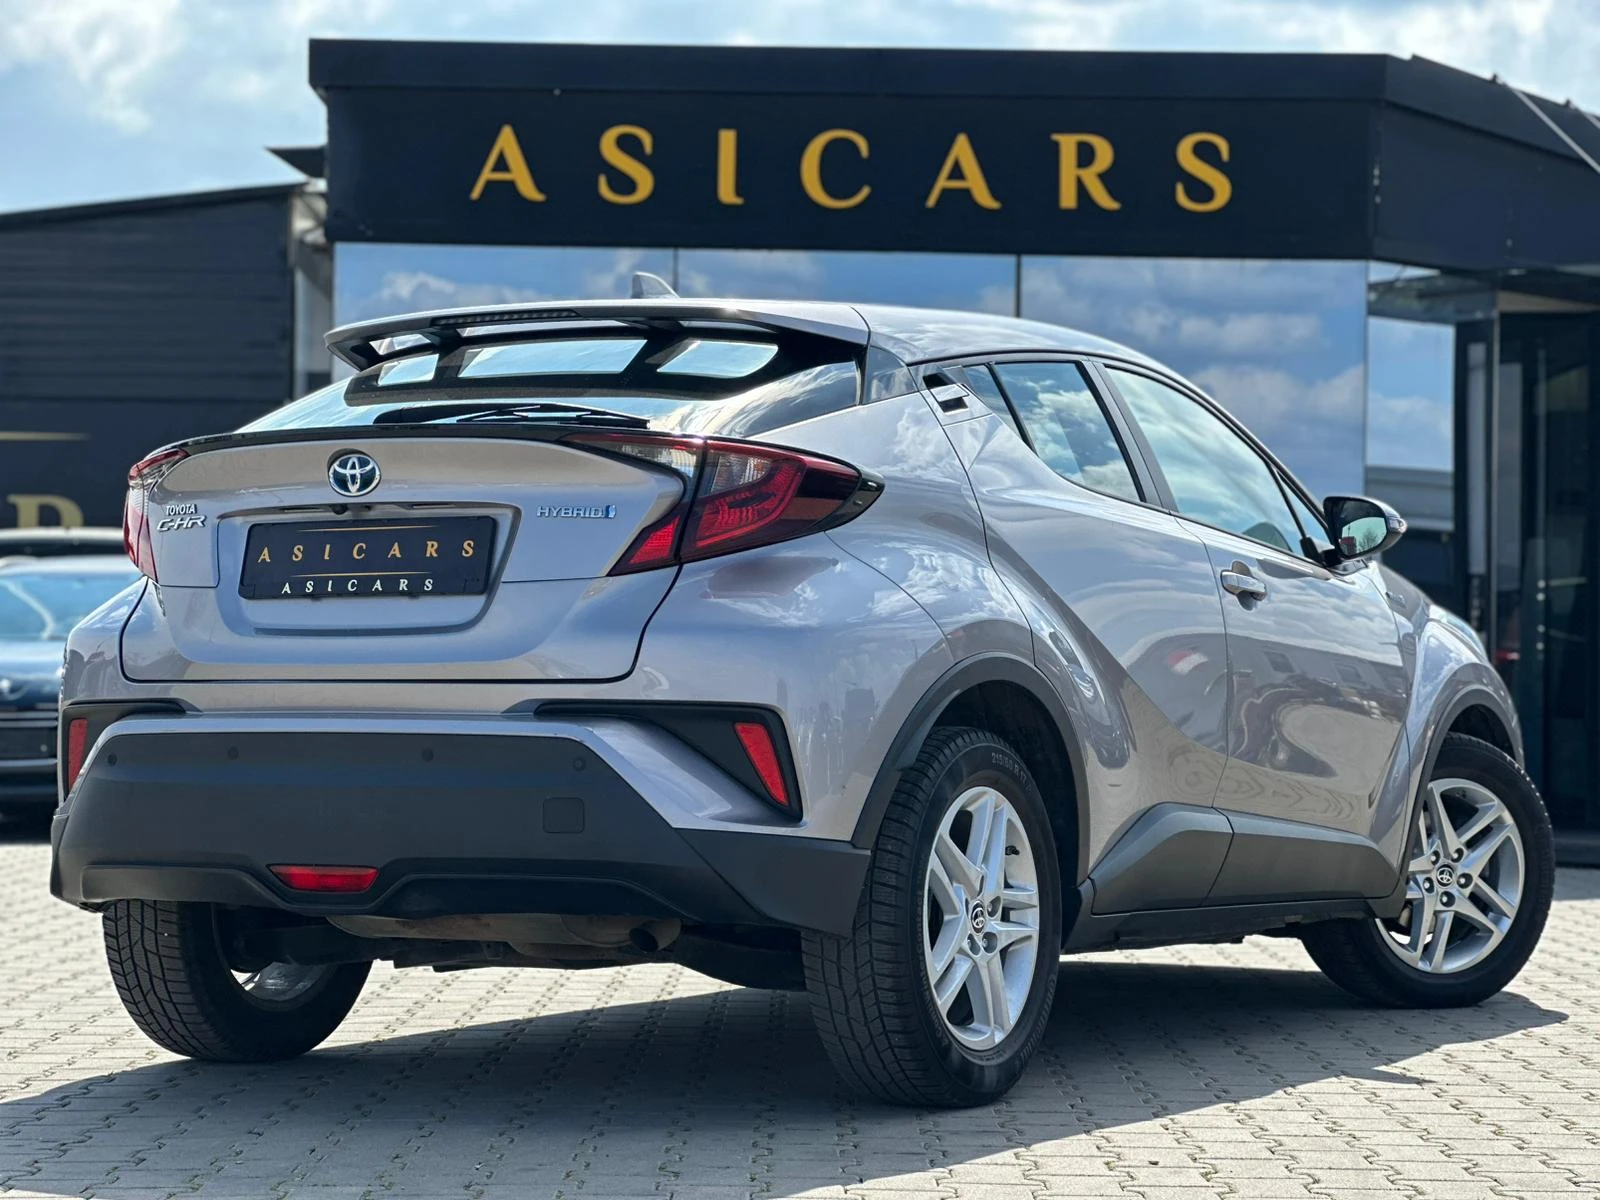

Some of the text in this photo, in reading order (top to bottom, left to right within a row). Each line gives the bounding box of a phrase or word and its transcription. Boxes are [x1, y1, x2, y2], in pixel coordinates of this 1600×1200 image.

[471, 124, 1234, 213] ASICARS
[166, 504, 197, 516] TOYOTA
[536, 506, 603, 519] HYBRID
[156, 515, 207, 532] C-HR
[258, 540, 475, 563] ASICARS
[281, 578, 434, 595] ASICARS
